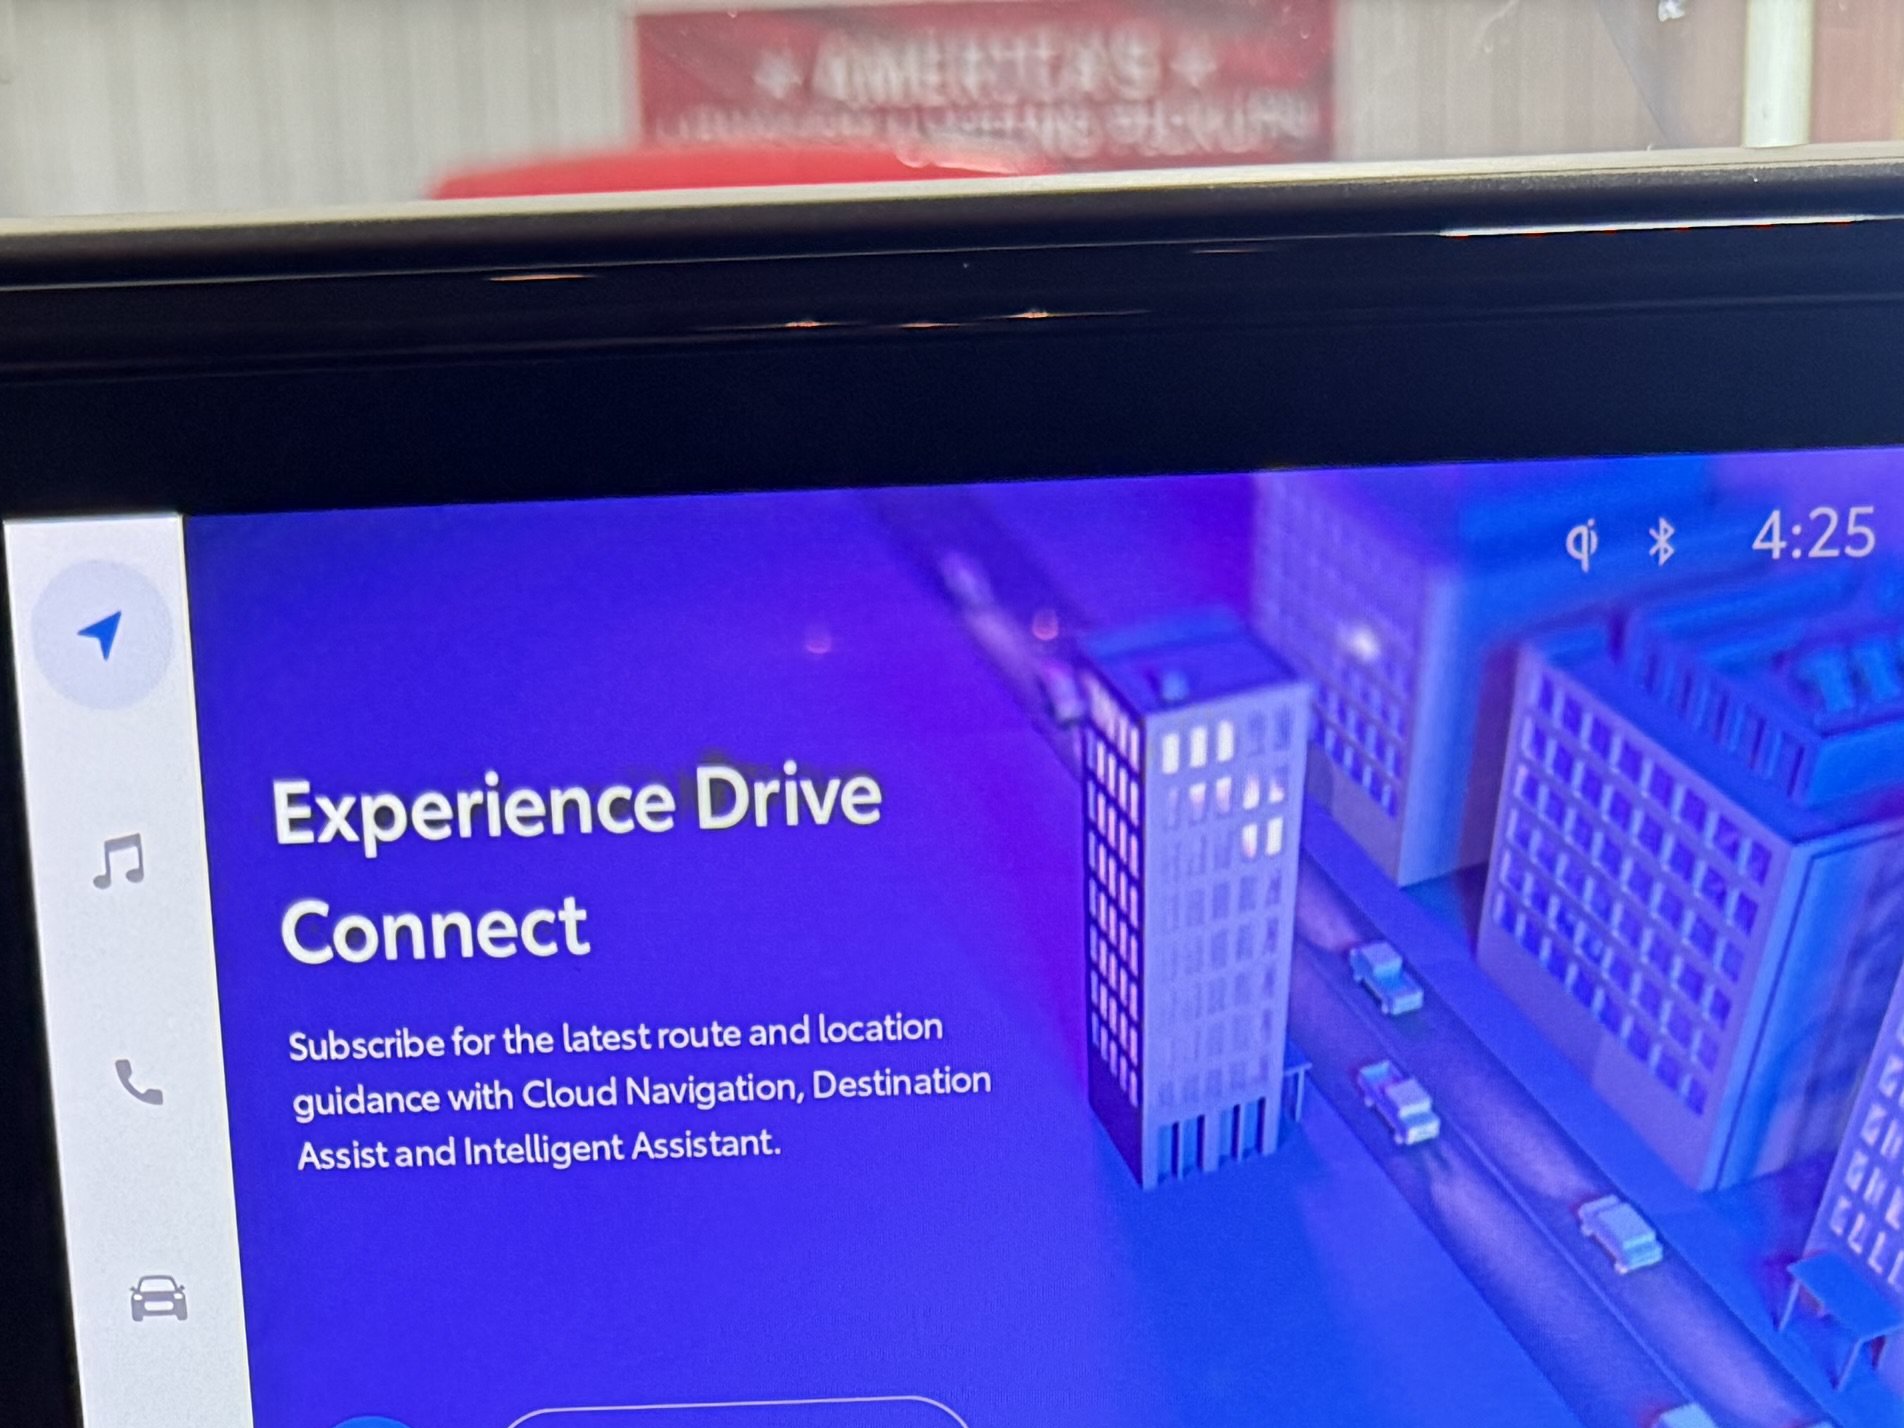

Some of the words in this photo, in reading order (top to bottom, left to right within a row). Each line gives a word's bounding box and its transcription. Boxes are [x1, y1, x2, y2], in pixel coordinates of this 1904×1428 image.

[1752, 506, 1876, 560] 4:25
[272, 769, 676, 857] Experience
[696, 760, 882, 831] Drive
[280, 895, 591, 964] Connect
[289, 1029, 445, 1061] Subscribe
[451, 1025, 495, 1056] for
[503, 1023, 554, 1055] the
[563, 1022, 651, 1052] latest
[658, 1020, 741, 1049] route
[749, 1013, 811, 1046] and
[819, 1011, 943, 1044] location
[293, 1083, 441, 1124] guidance
[448, 1080, 513, 1111] with
[522, 1075, 618, 1109] Cloud
[626, 1073, 805, 1110] Navigation,
[813, 1066, 992, 1099] Destination
[298, 1140, 389, 1171] Assist
[395, 1136, 456, 1167] and
[465, 1133, 624, 1170] Intelligent
[632, 1129, 781, 1160] Assistant.
